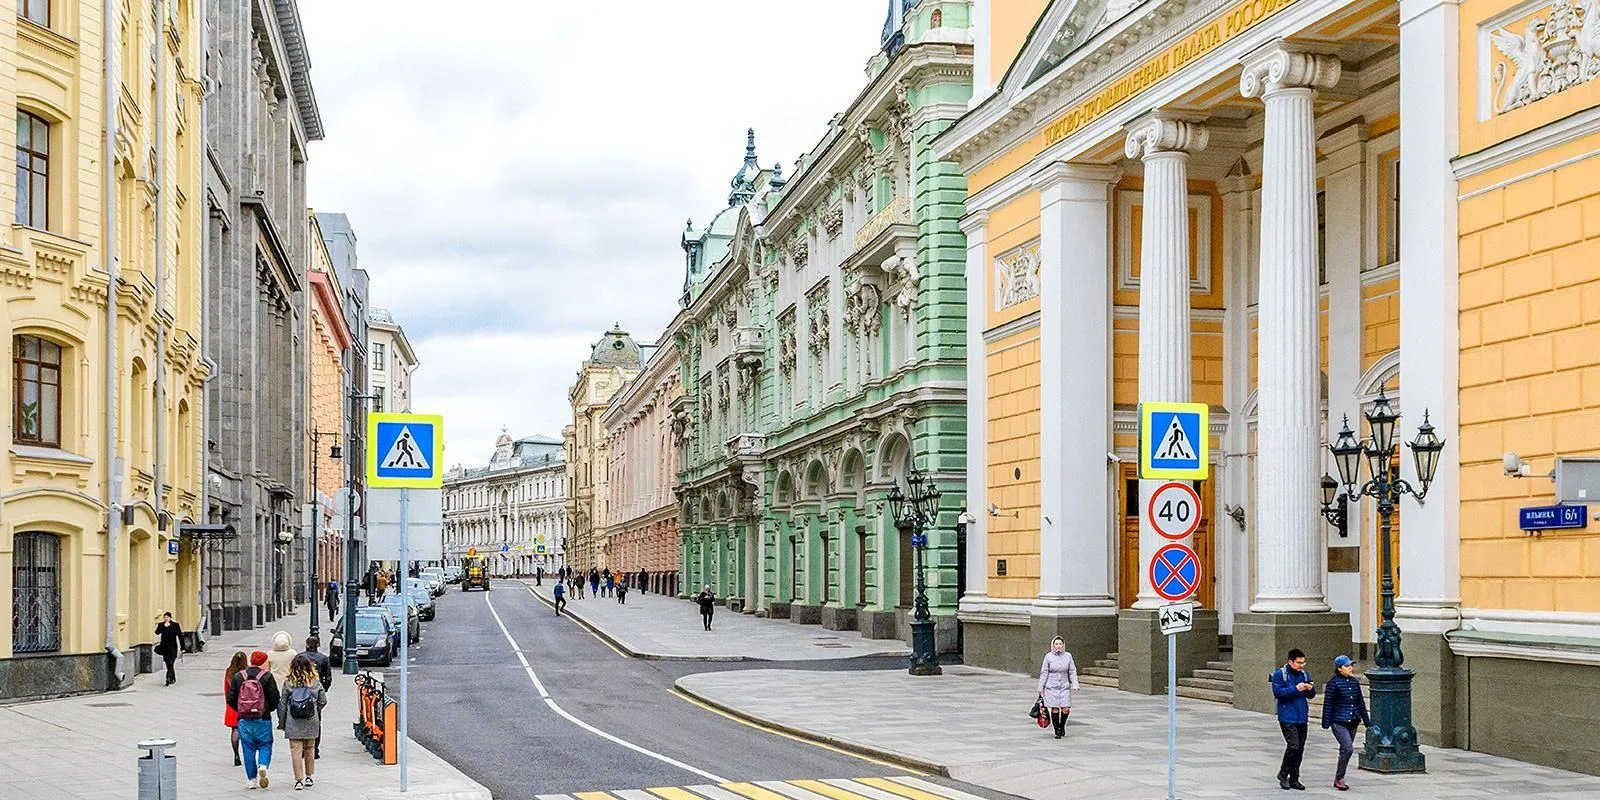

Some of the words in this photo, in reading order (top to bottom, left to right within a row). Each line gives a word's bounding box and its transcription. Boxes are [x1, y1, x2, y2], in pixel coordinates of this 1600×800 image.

[1173, 23, 1221, 69] ПАЛАТА
[1159, 500, 1190, 522] 40
[1526, 510, 1555, 519] ИЛЬИНКА
[1565, 508, 1578, 520] 6/1
